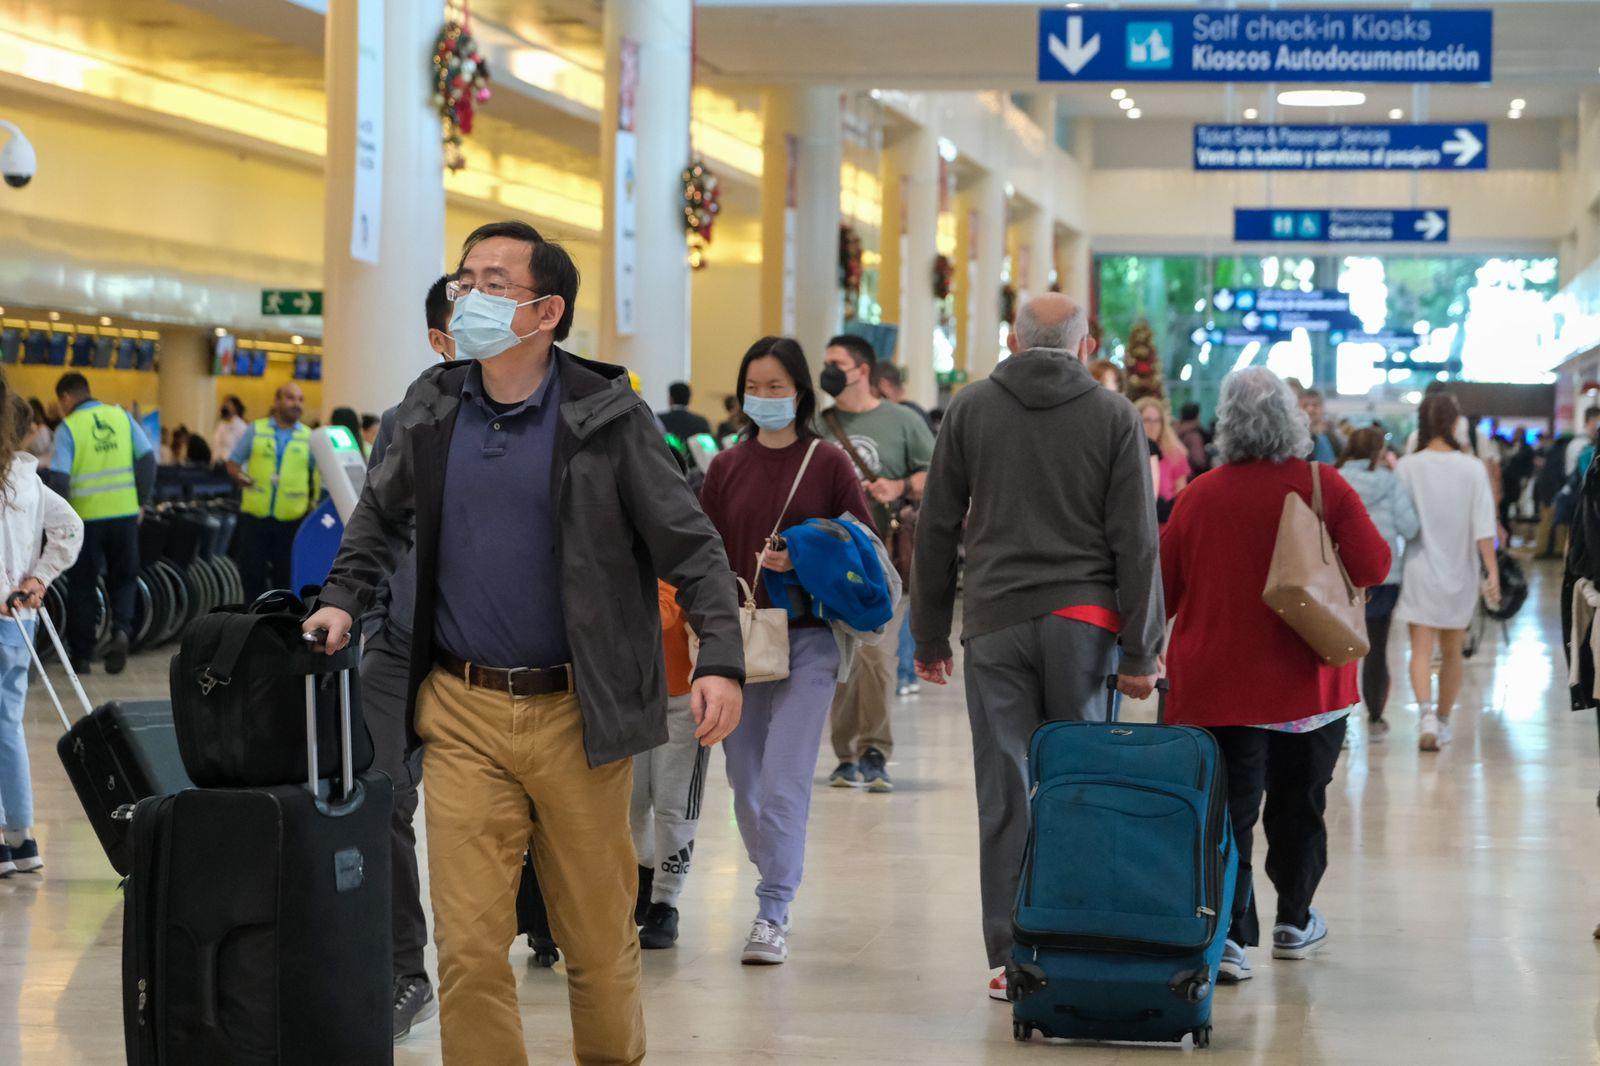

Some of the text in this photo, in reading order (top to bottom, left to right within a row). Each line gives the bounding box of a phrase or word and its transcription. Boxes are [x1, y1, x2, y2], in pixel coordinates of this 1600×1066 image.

[1192, 14, 1431, 40] Self check-in Kiosks
[1192, 43, 1480, 71] Kioscos Autodocumentación
[1197, 147, 1235, 166] Venta
[1236, 147, 1253, 166] de
[1304, 150, 1313, 168] y
[1315, 147, 1369, 166] servicios
[1384, 146, 1440, 168] pasajero
